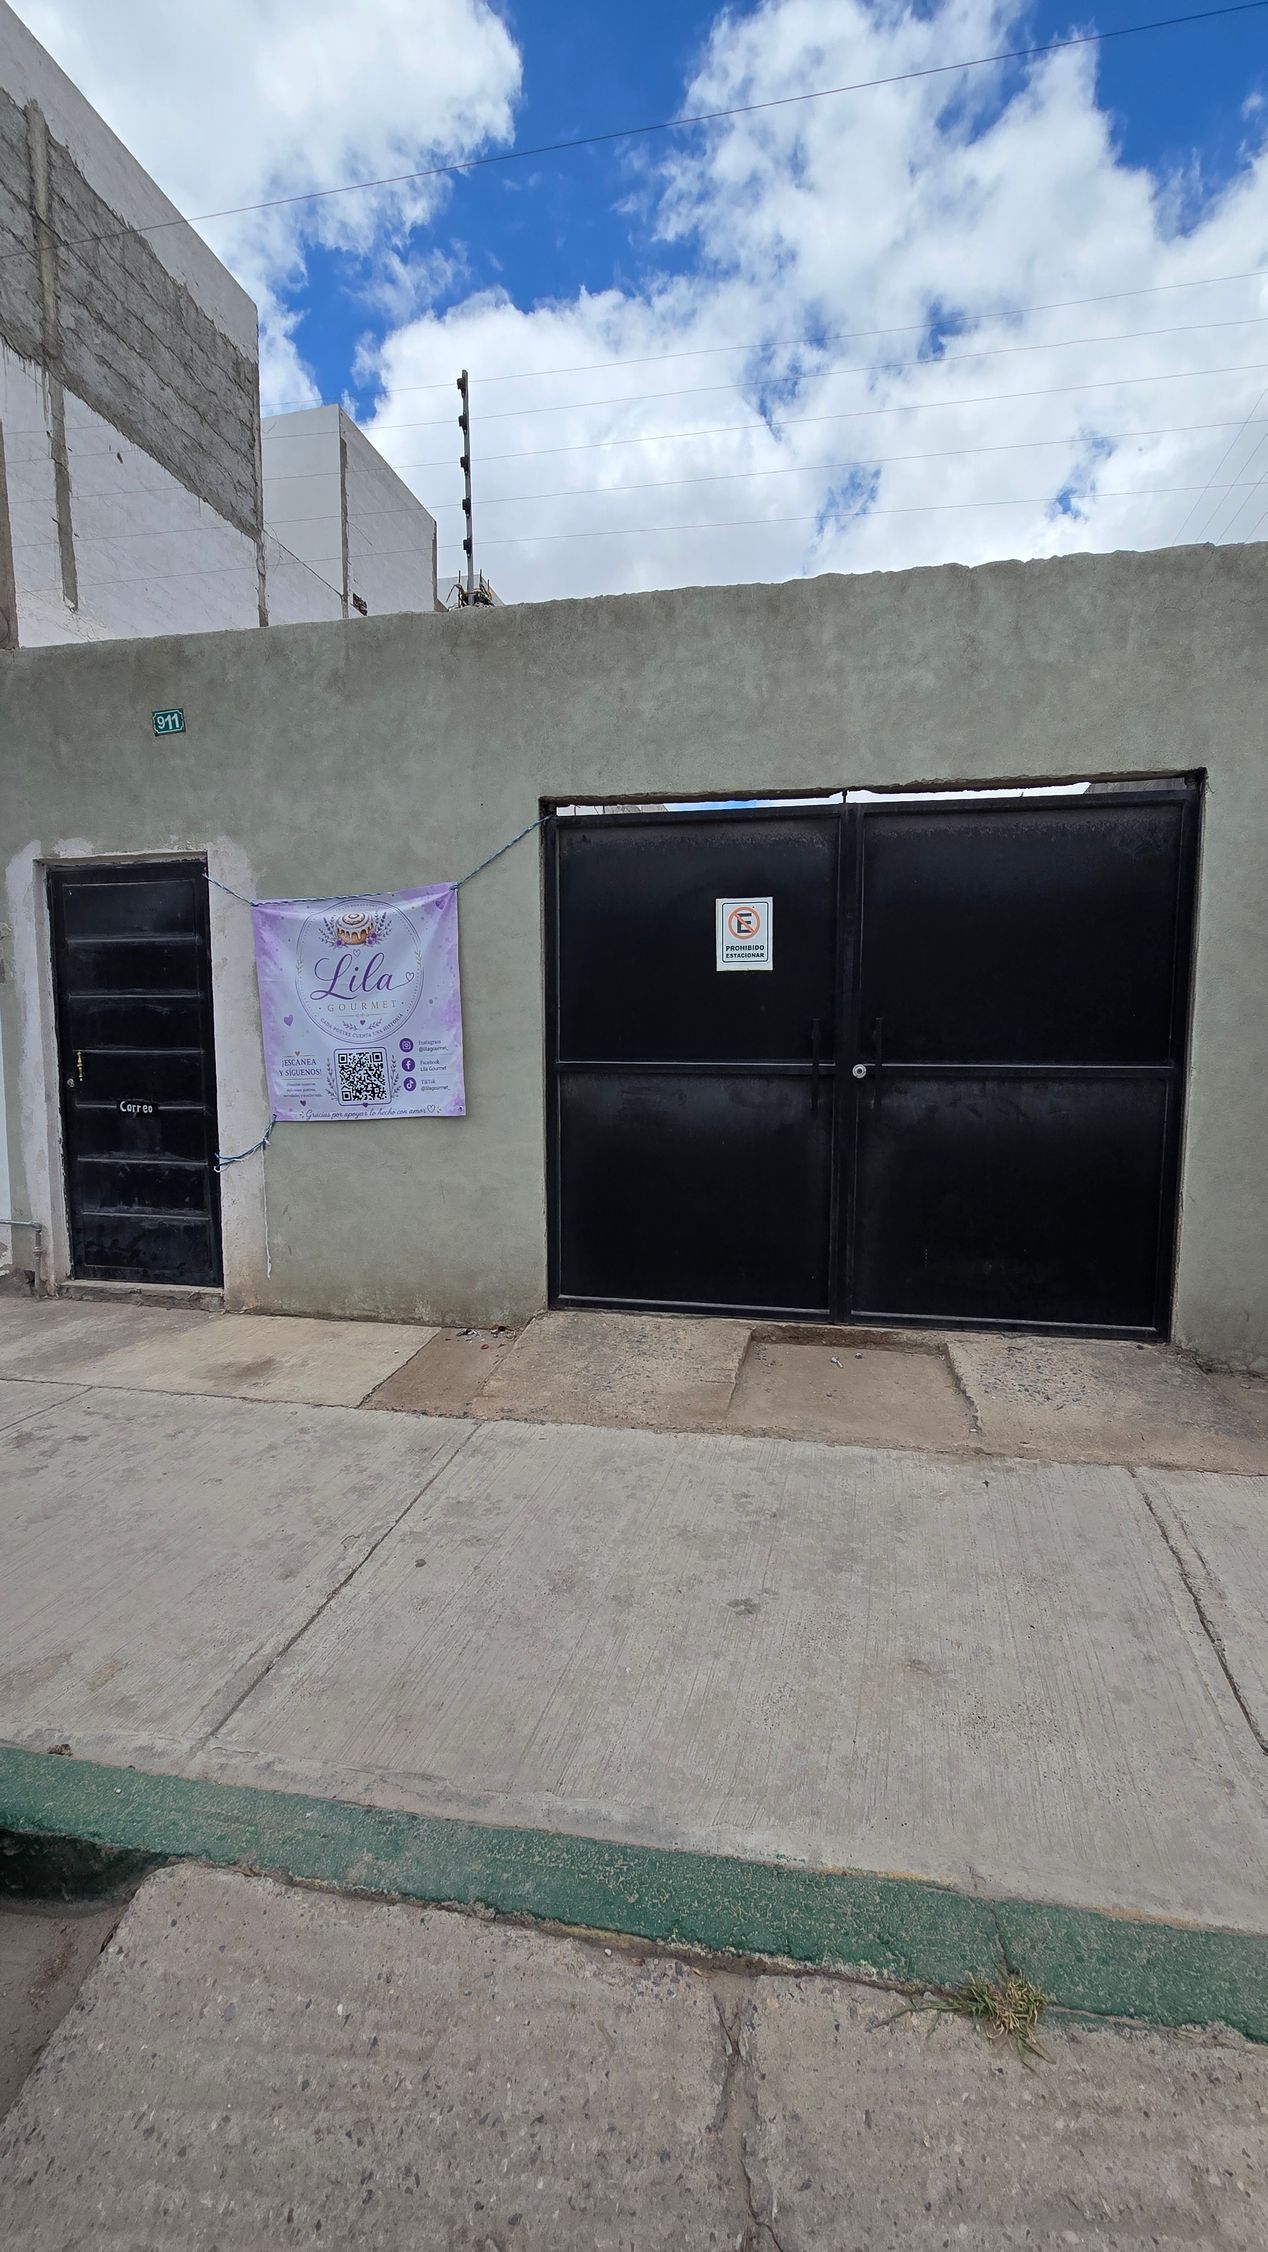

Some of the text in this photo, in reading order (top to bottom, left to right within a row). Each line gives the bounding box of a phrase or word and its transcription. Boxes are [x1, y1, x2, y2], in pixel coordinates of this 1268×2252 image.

[157, 713, 180, 729] 911
[310, 952, 402, 1000] Lila
[327, 1000, 396, 1012] GOURMET
[383, 1013, 404, 1031] HISTORIA
[281, 1058, 317, 1067] ¡ESCANEA
[285, 1068, 322, 1077] SÍGUENOS!
[120, 1101, 153, 1113] Correo
[305, 1109, 331, 1120] Gracias
[344, 1112, 367, 1120] apoyar
[377, 1107, 396, 1116] hecho
